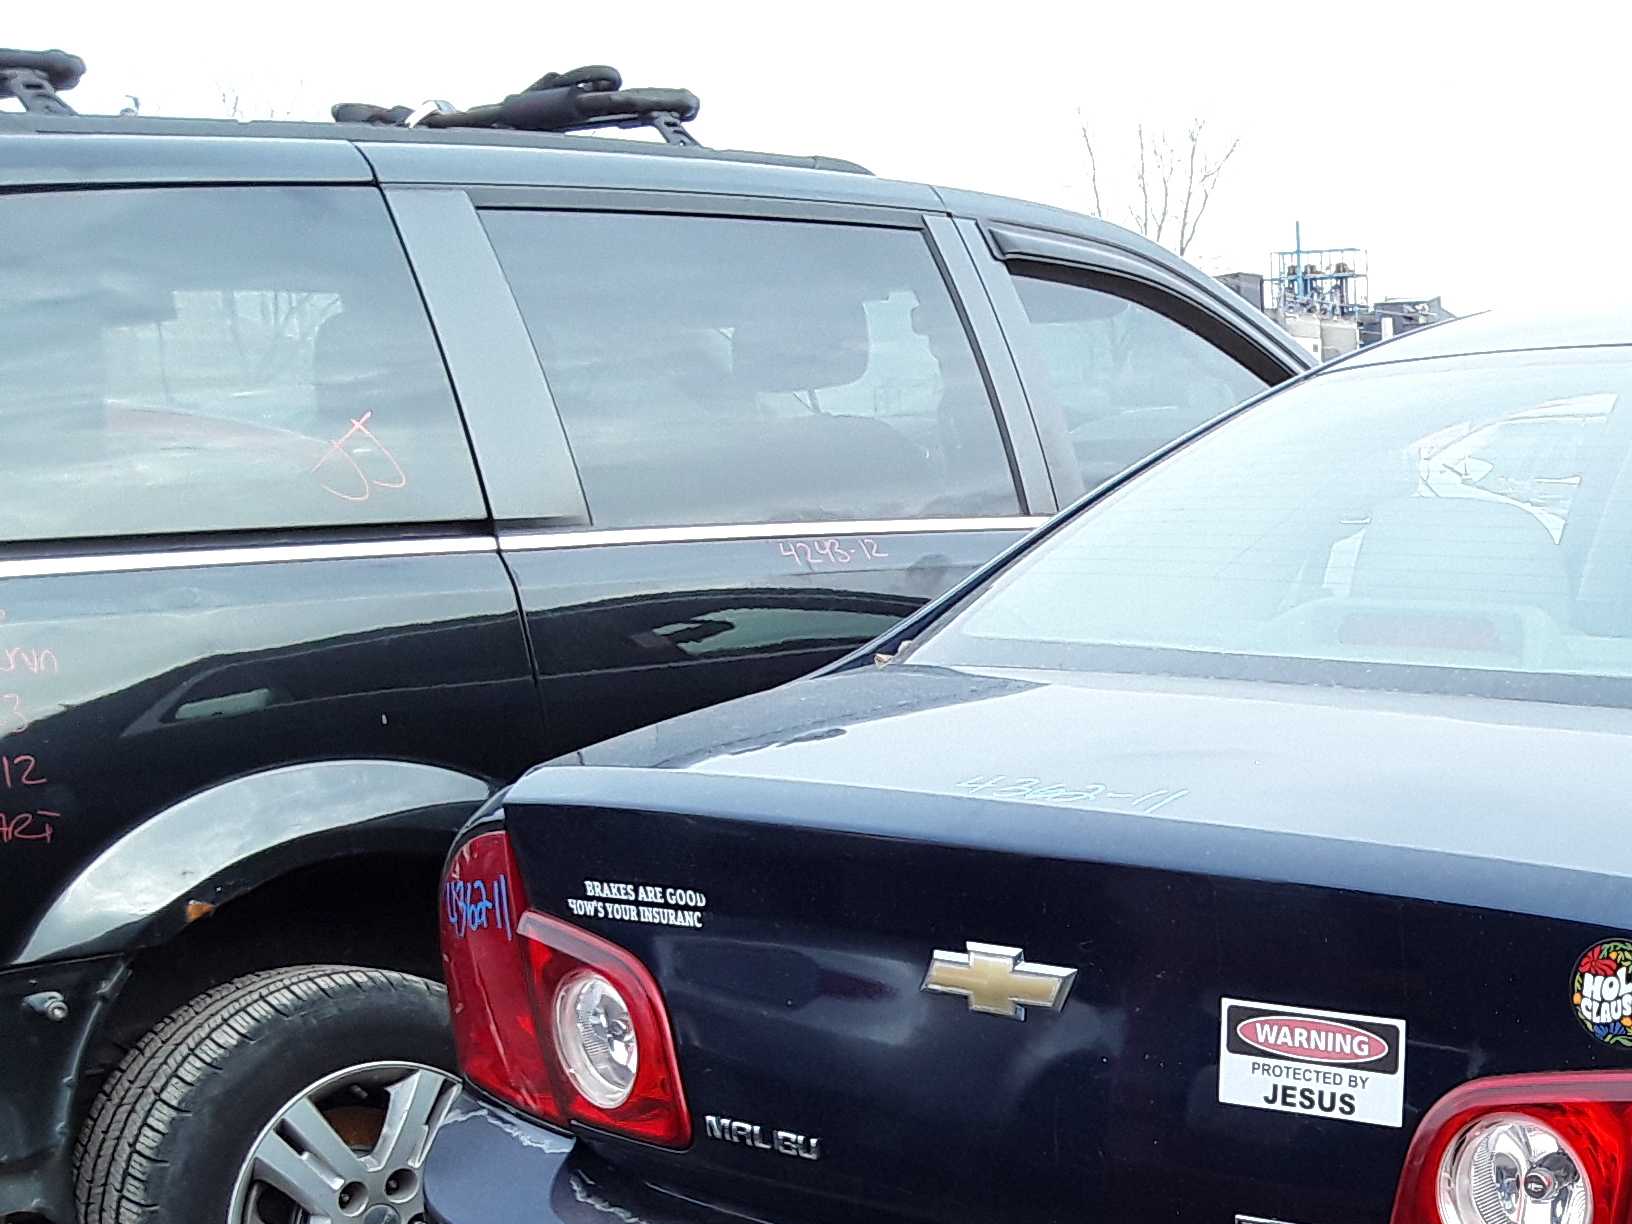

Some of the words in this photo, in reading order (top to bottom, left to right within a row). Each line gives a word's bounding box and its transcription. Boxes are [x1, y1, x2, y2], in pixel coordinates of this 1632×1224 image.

[778, 539, 889, 566] 4243-12
[956, 775, 1190, 814] 4362-11
[584, 880, 636, 901] BRAKES
[638, 885, 665, 904] ARE
[666, 888, 706, 907] GOOD
[605, 902, 639, 922] YOUR
[1255, 1022, 1371, 1057] WARNING
[1251, 1062, 1344, 1086] PROTECTED
[1348, 1074, 1370, 1090] BY
[1263, 1083, 1357, 1116] JESUS
[704, 1114, 822, 1161] MALIBU
